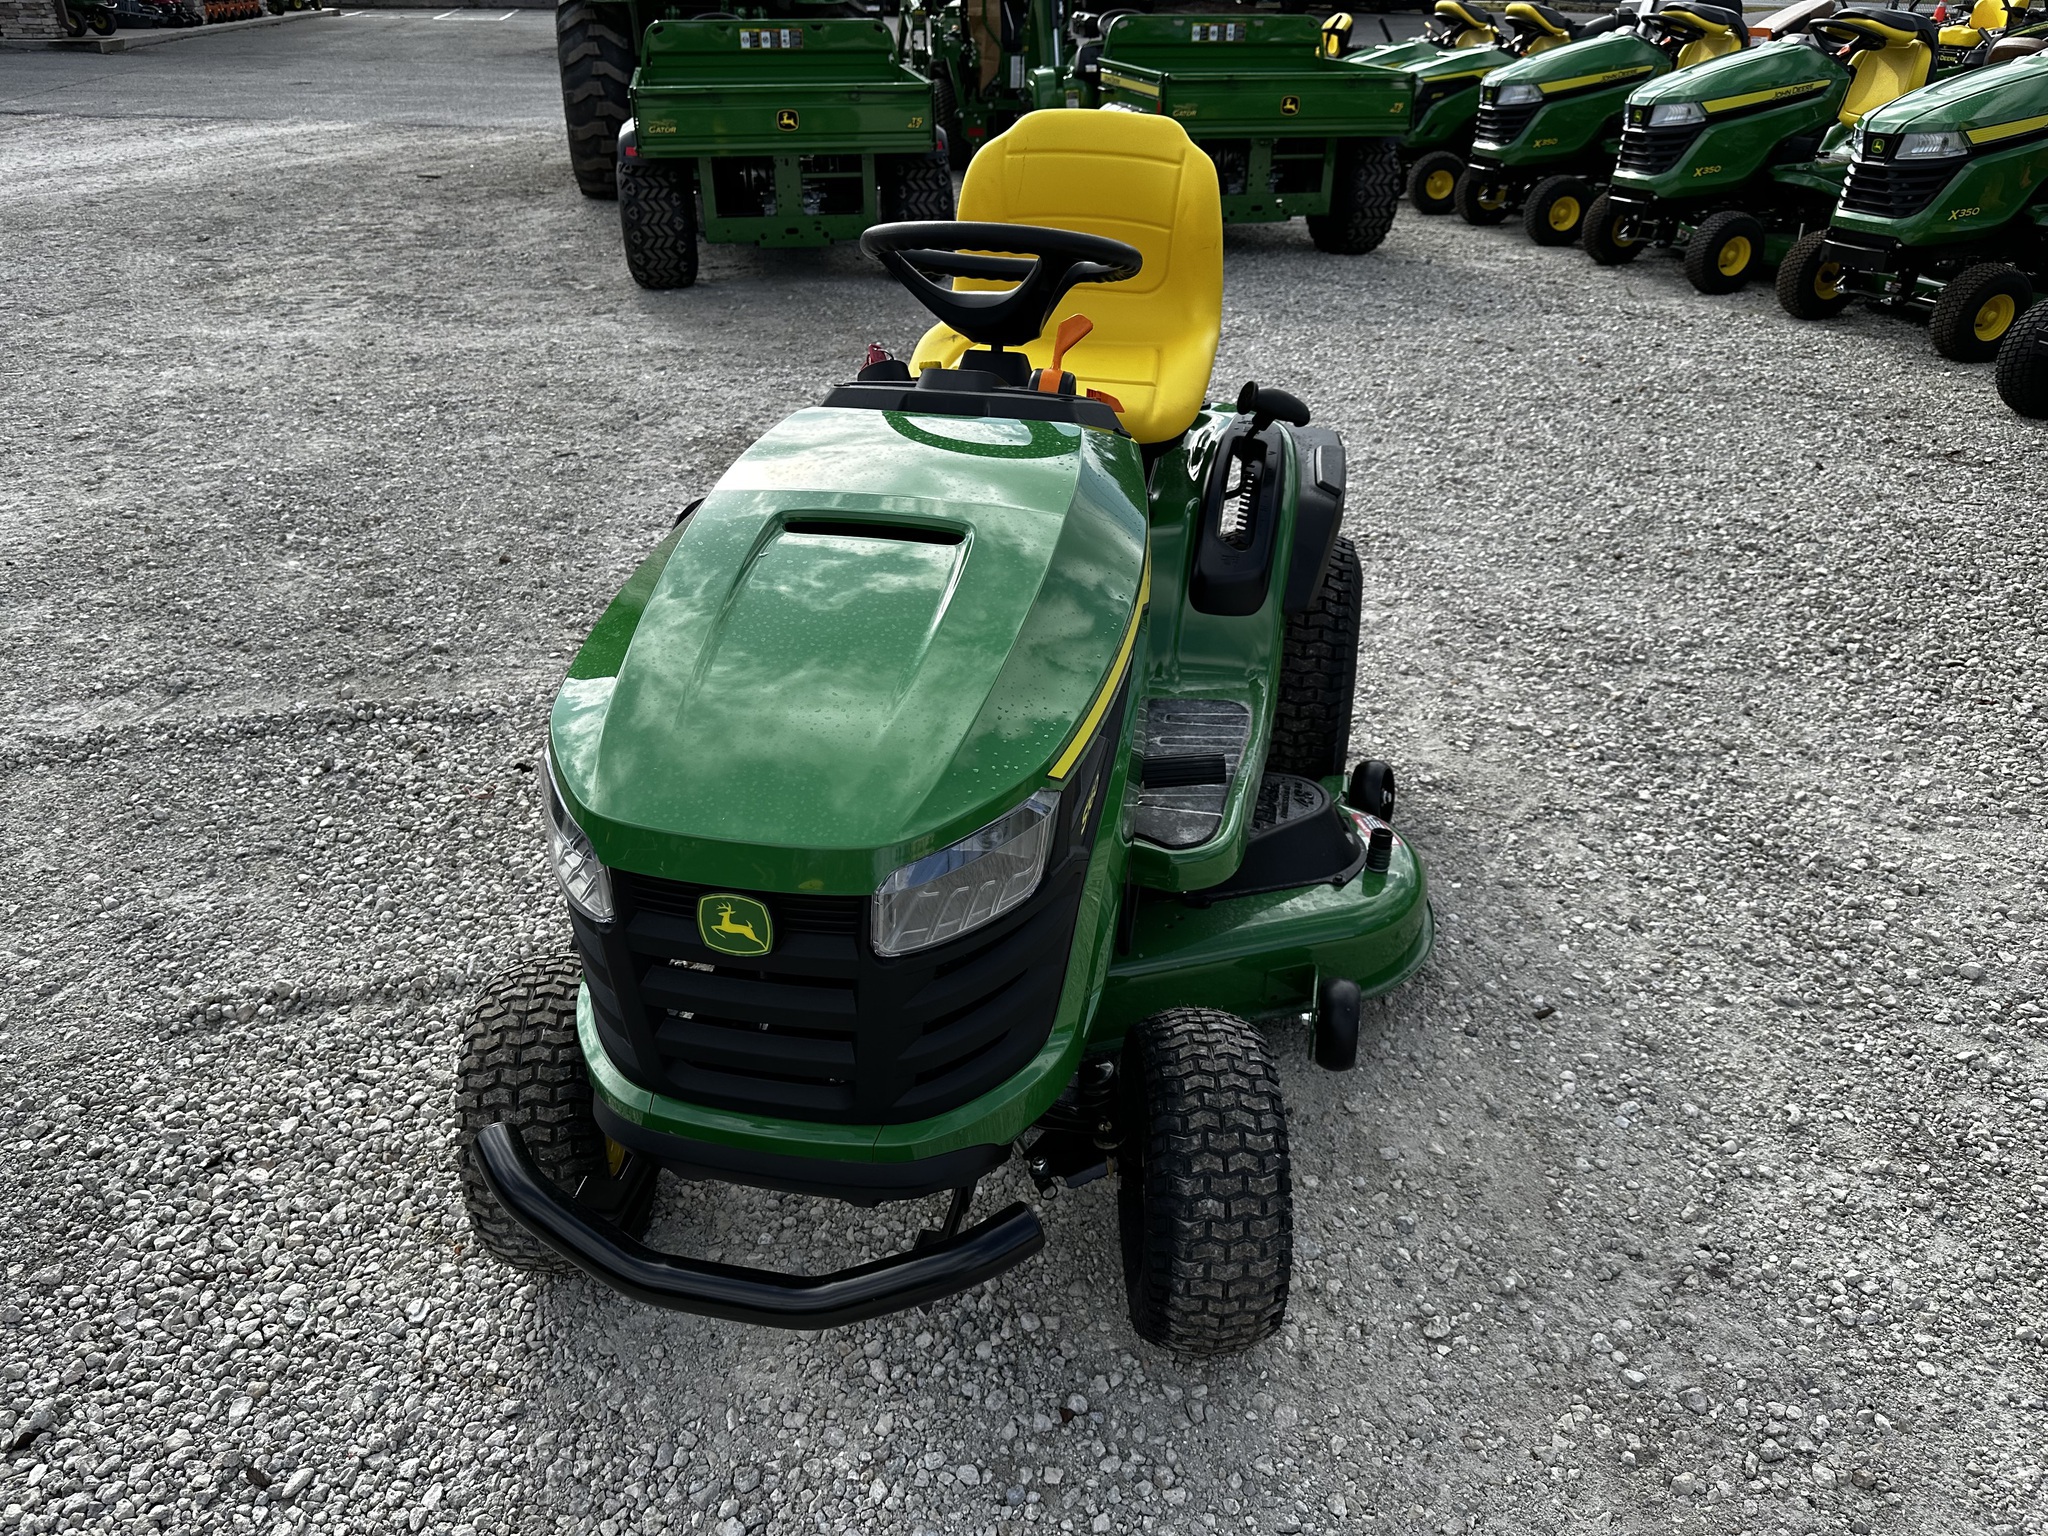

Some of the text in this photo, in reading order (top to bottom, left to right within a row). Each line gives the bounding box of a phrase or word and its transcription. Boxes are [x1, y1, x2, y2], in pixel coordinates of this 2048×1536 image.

[1772, 83, 1814, 100] JOHN DEERE
[649, 126, 677, 134] GATOR
[1693, 165, 1721, 177] X350
[1948, 207, 1980, 220] X350
